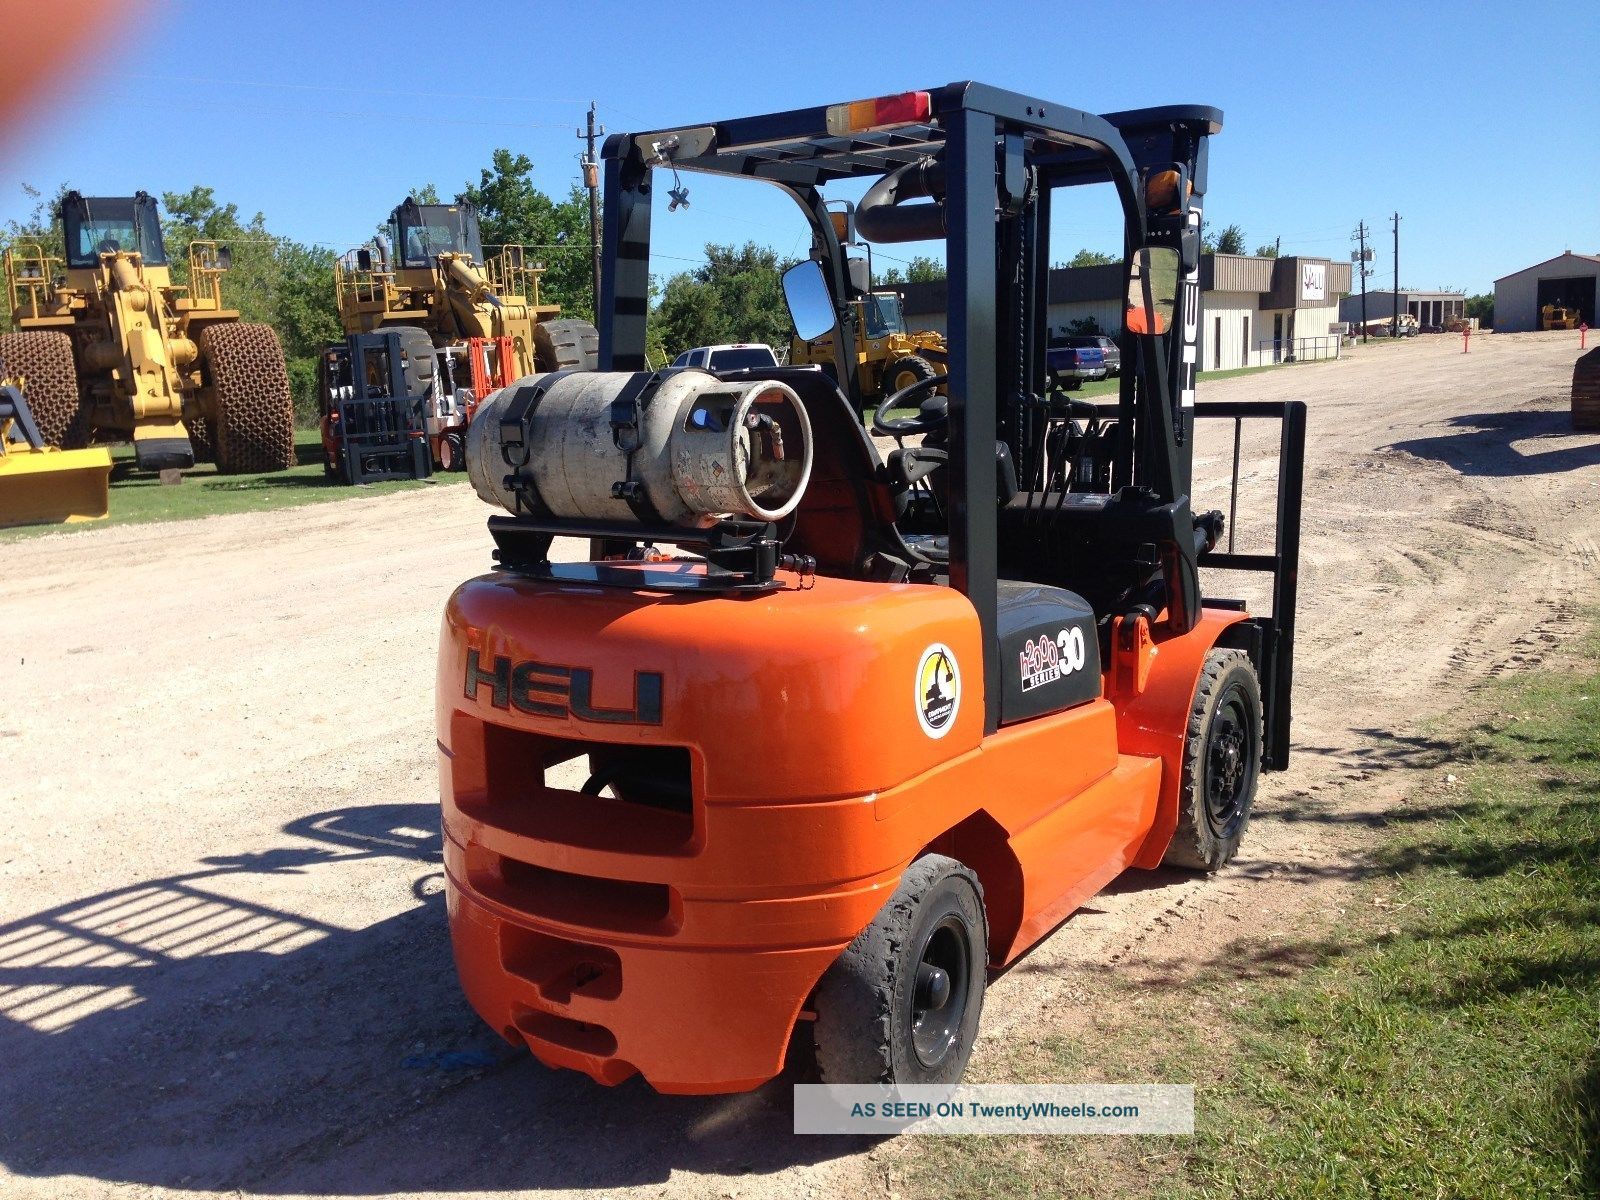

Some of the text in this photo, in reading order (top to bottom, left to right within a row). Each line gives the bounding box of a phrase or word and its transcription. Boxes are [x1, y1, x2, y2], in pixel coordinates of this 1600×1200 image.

[1058, 625, 1086, 675] 30
[464, 646, 664, 726] HELI
[1029, 667, 1060, 687] SERIES
